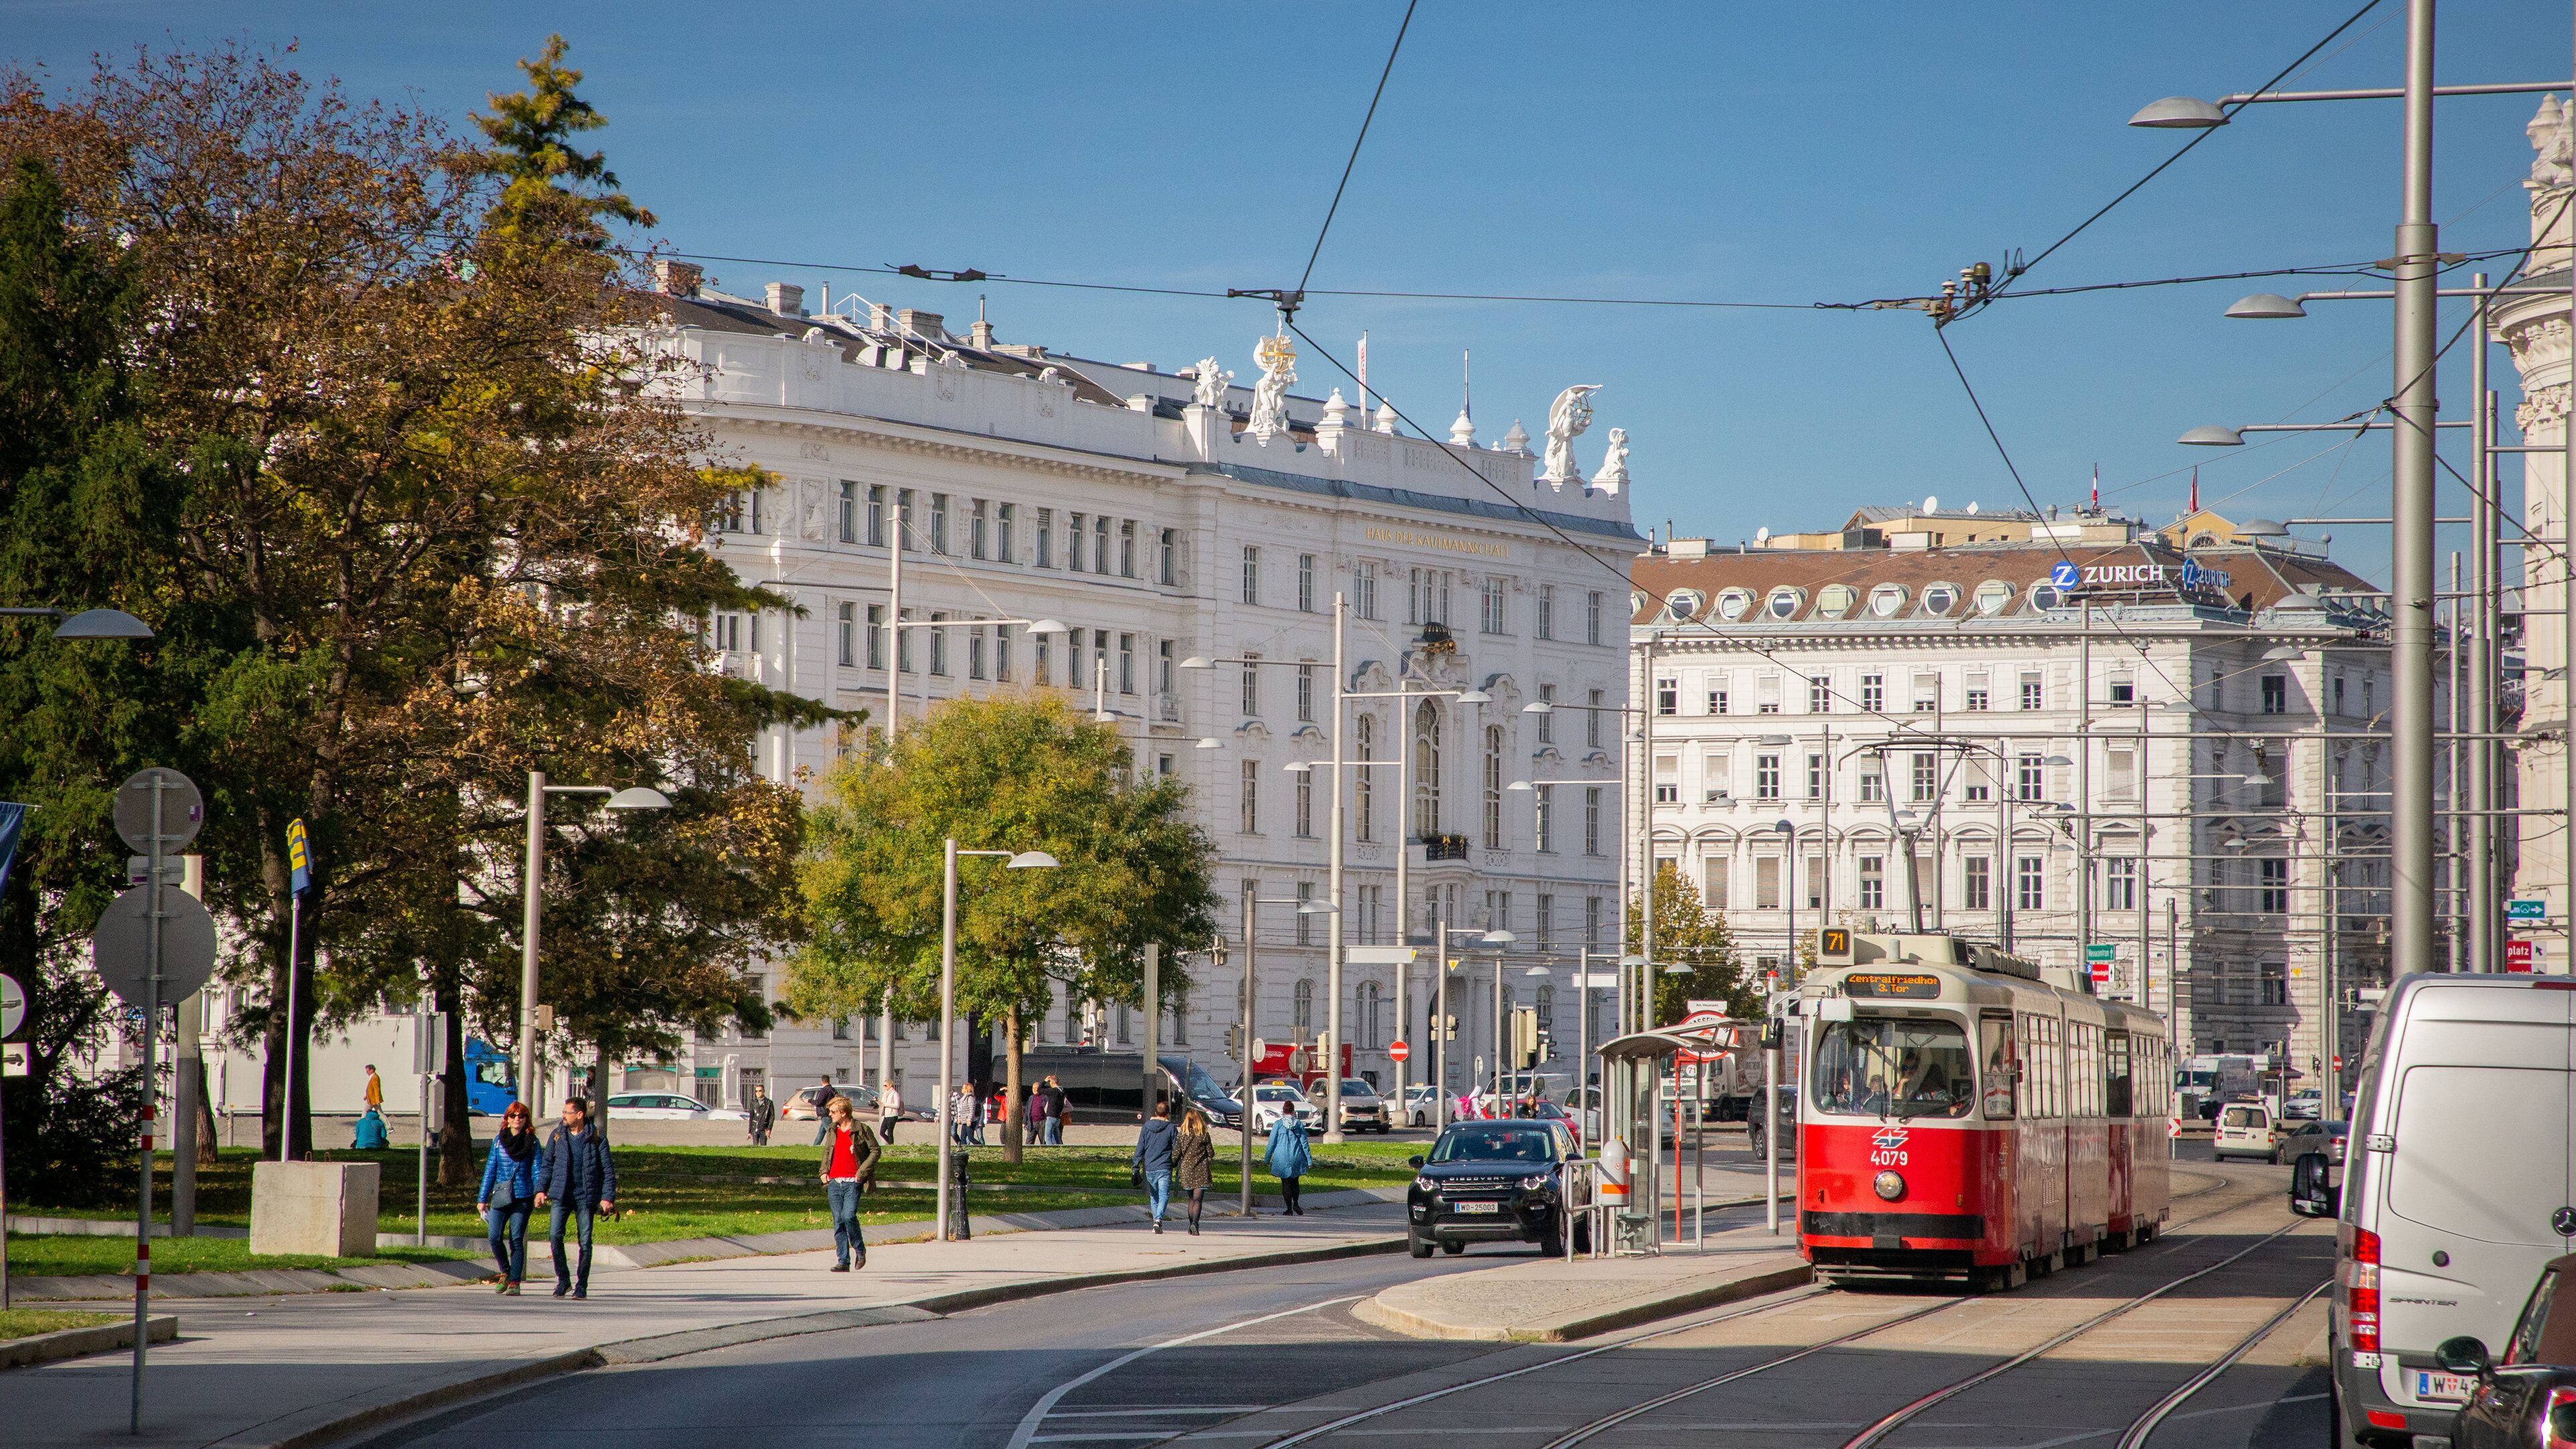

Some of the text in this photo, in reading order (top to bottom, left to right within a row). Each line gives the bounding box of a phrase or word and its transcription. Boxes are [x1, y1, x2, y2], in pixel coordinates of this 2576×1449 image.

[1366, 527, 1511, 558] HAUS DER KAUFMANNSCHAFT
[2084, 564, 2164, 583] ZURICH
[2198, 568, 2231, 588] ZURICH
[1827, 932, 1843, 951] 71
[1849, 975, 1937, 985] Zentralfriedhof
[1878, 983, 1909, 993] 3. Tor
[1870, 1150, 1908, 1166] 4079
[2389, 1297, 2458, 1307] SPRINTER
